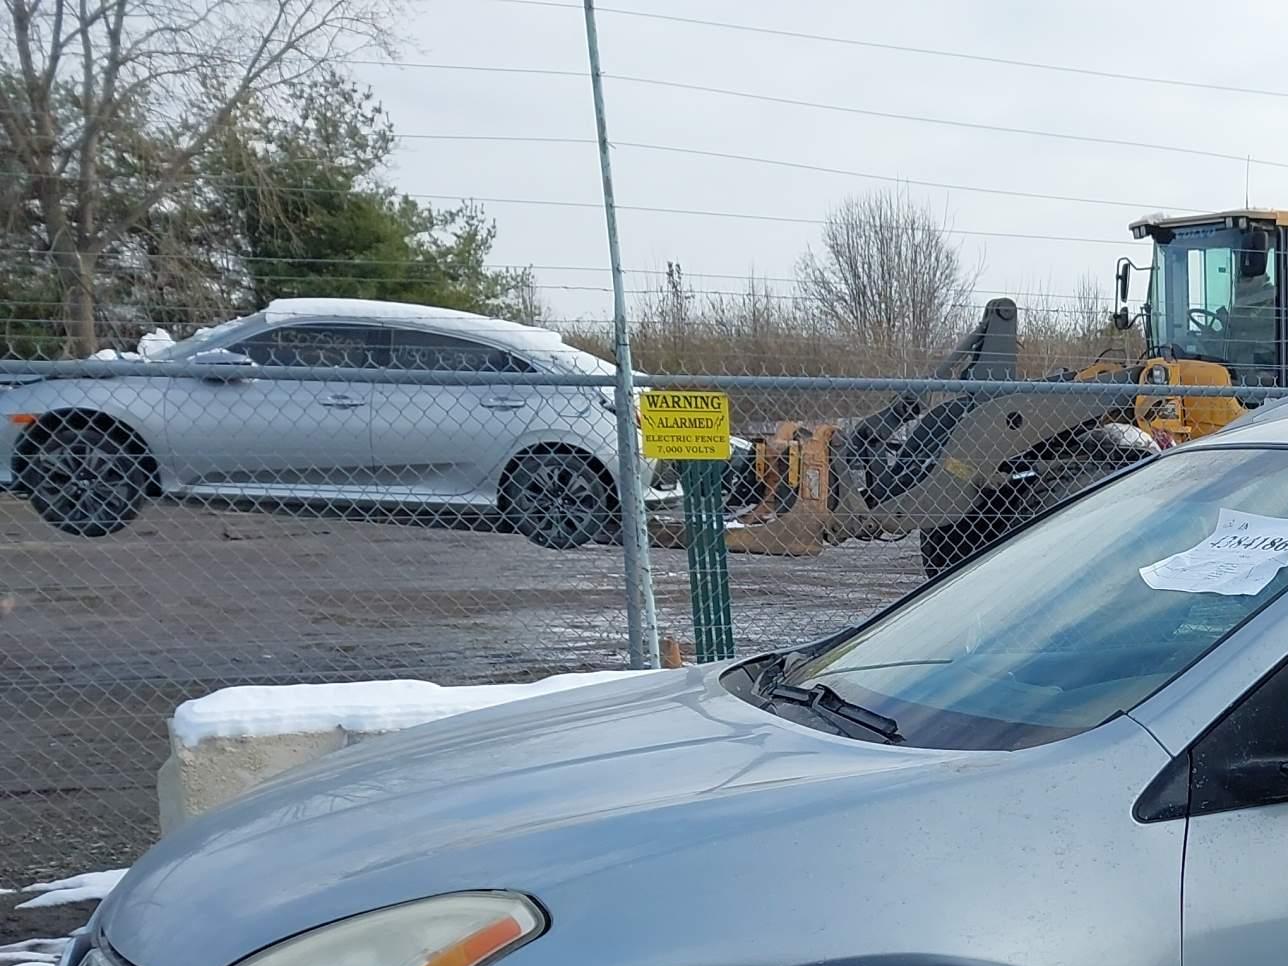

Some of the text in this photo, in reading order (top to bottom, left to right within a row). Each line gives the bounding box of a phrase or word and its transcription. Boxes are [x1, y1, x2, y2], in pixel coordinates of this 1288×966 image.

[646, 395, 721, 410] WARNING
[656, 417, 714, 429] ALARMED
[646, 435, 725, 443] ELECTRIC FENCE
[658, 446, 683, 454] 7,000
